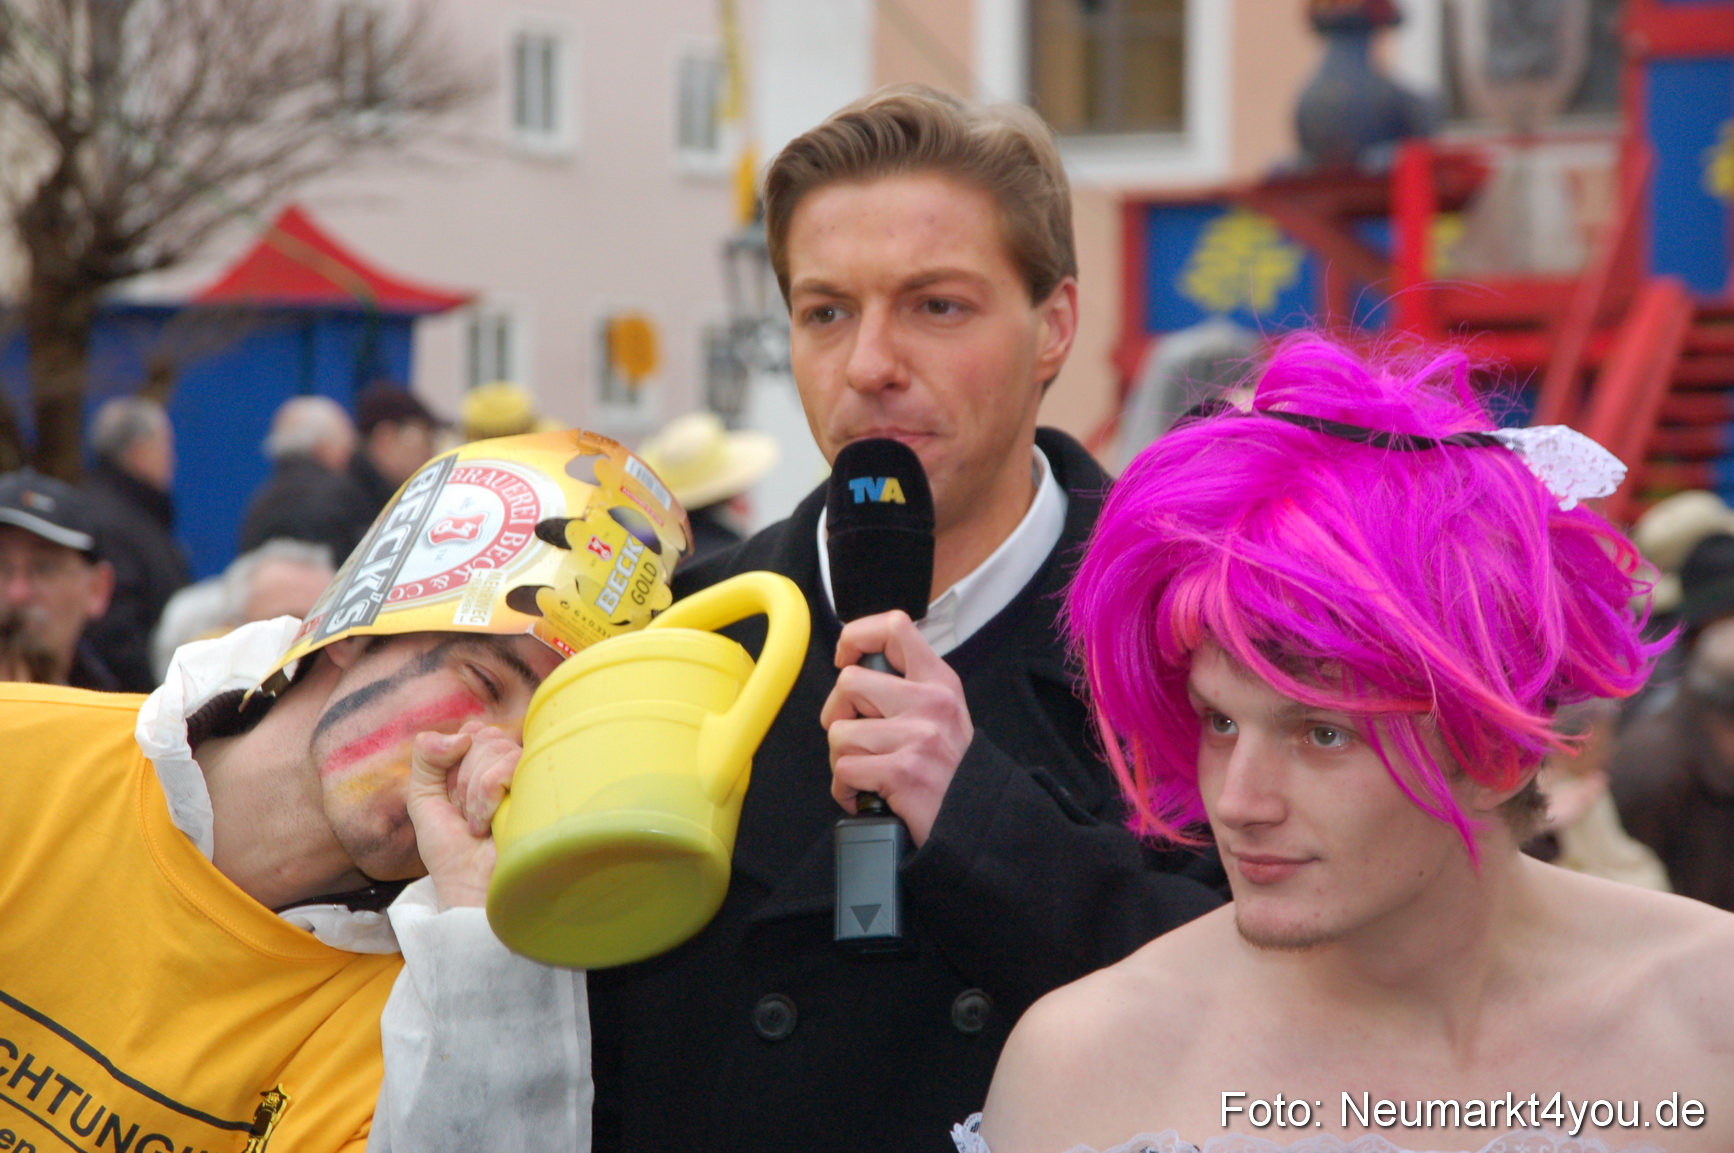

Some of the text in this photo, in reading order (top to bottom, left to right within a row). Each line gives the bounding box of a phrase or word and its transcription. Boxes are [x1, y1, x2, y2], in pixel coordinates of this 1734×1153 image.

[449, 468, 536, 525] BRAUEREI
[848, 476, 907, 505] TVA
[326, 460, 446, 634] BECK'S
[453, 530, 527, 582] BECK
[429, 574, 450, 590] &
[631, 561, 658, 606] GOLD
